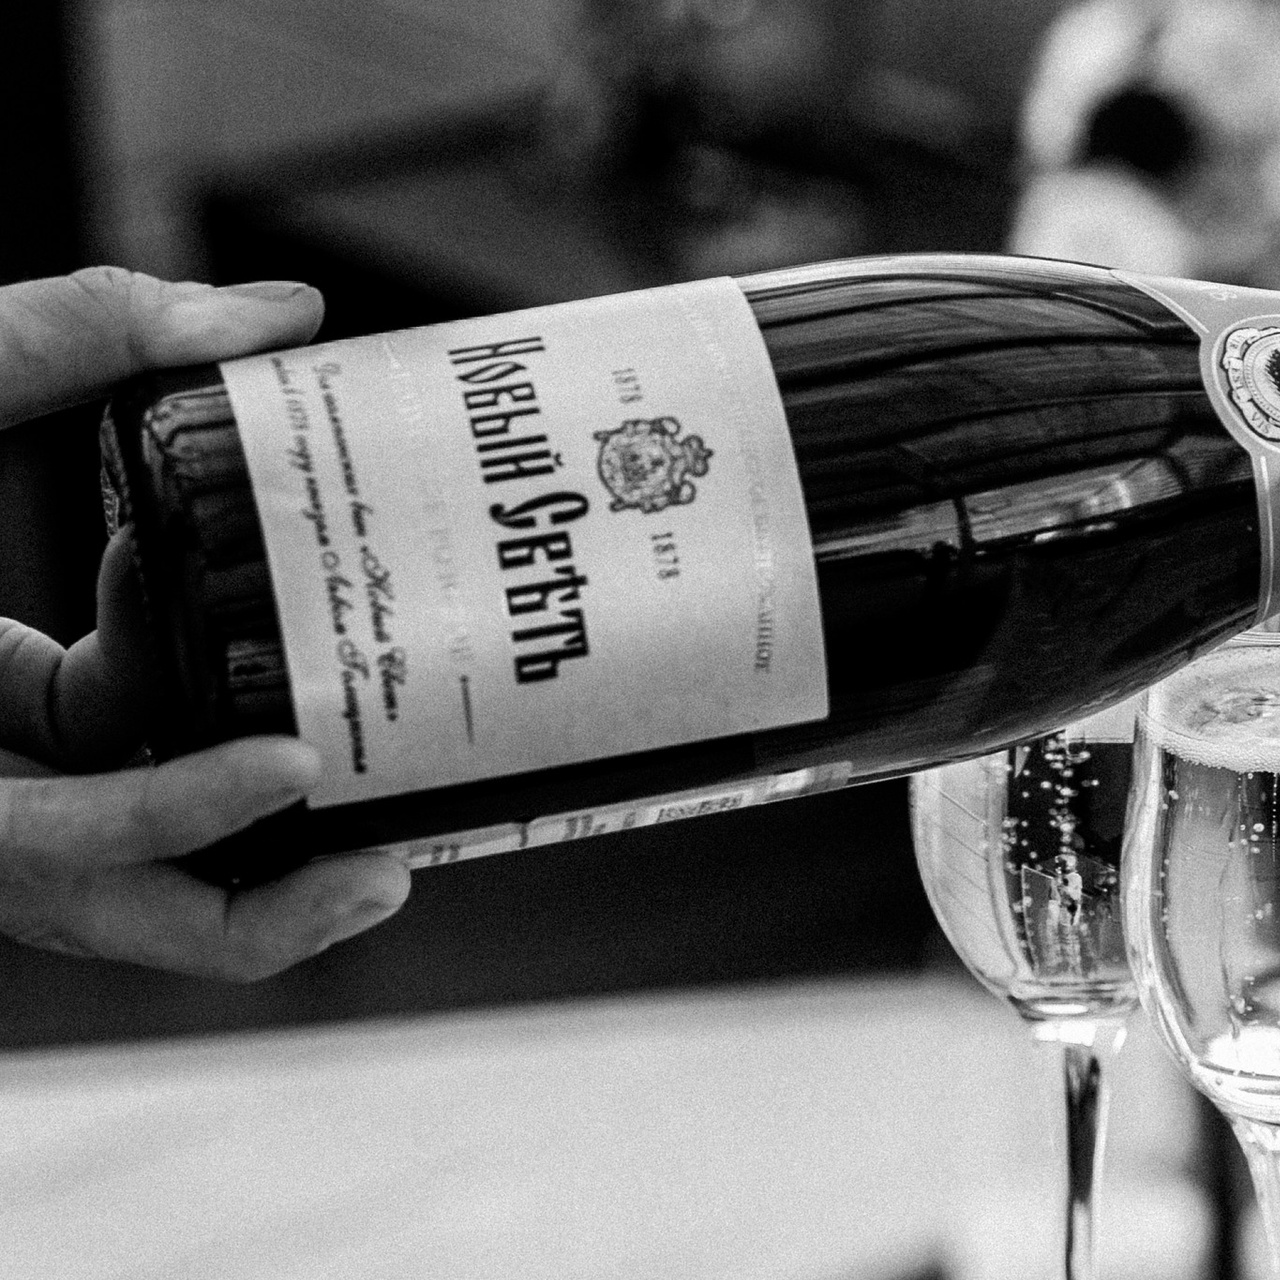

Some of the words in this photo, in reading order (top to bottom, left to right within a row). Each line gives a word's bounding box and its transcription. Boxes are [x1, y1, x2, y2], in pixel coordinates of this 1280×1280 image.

[611, 367, 644, 405] 1878
[1250, 413, 1271, 435] VIS
[650, 531, 681, 580] 1878
